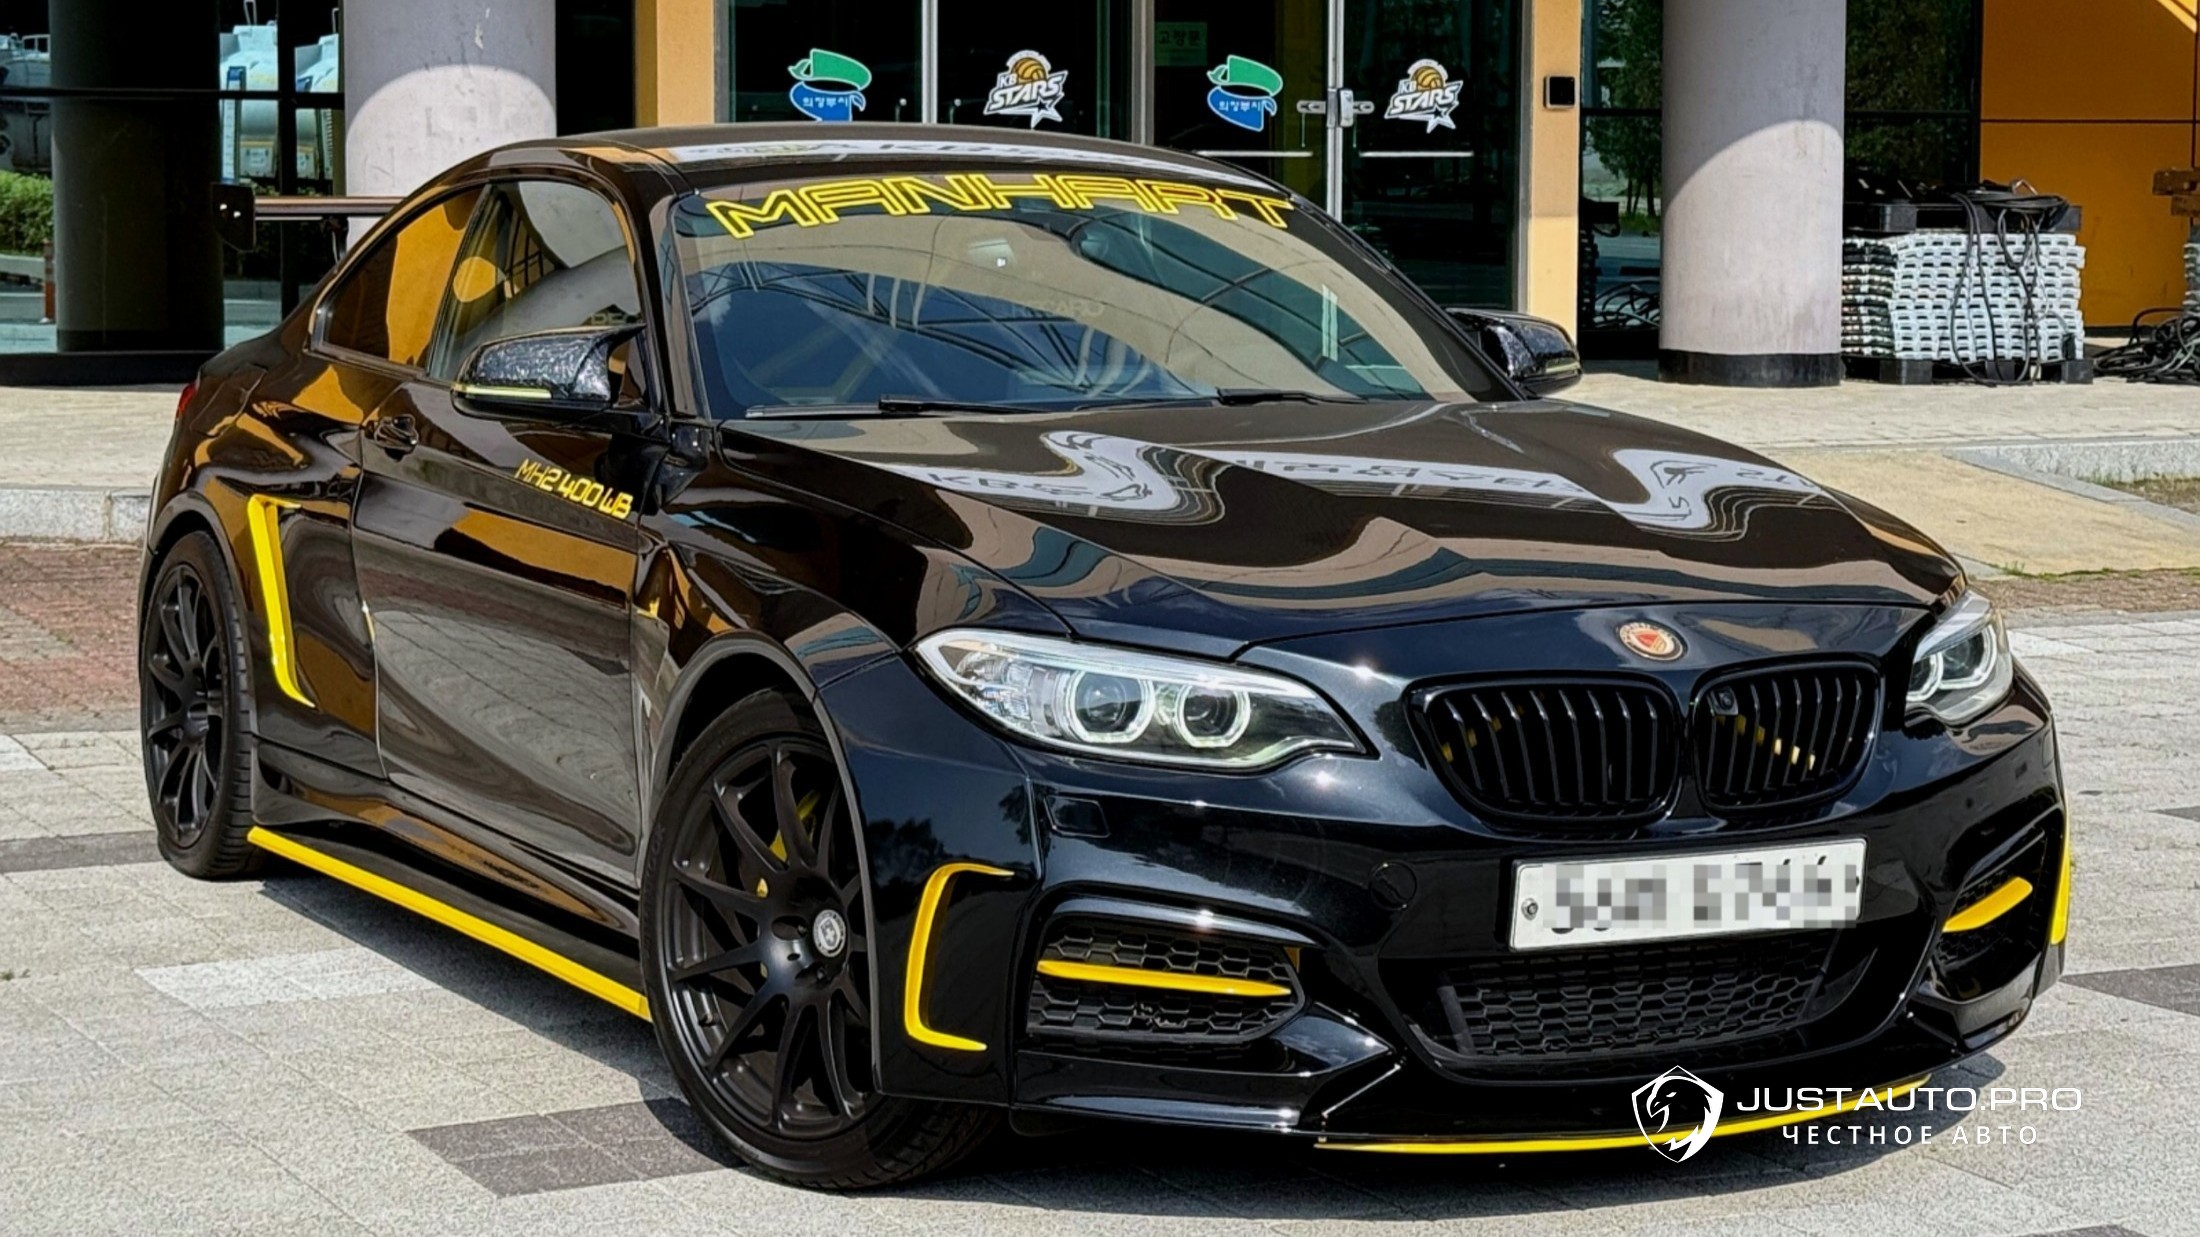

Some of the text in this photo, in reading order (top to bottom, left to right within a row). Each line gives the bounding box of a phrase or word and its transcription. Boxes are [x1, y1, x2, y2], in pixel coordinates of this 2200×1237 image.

[802, 96, 848, 108] 의정부시
[989, 75, 1064, 110] STARS
[1219, 101, 1261, 112] 의정부시
[1390, 84, 1461, 114] STARS
[706, 173, 1293, 239] MANHART
[557, 473, 604, 507] 400
